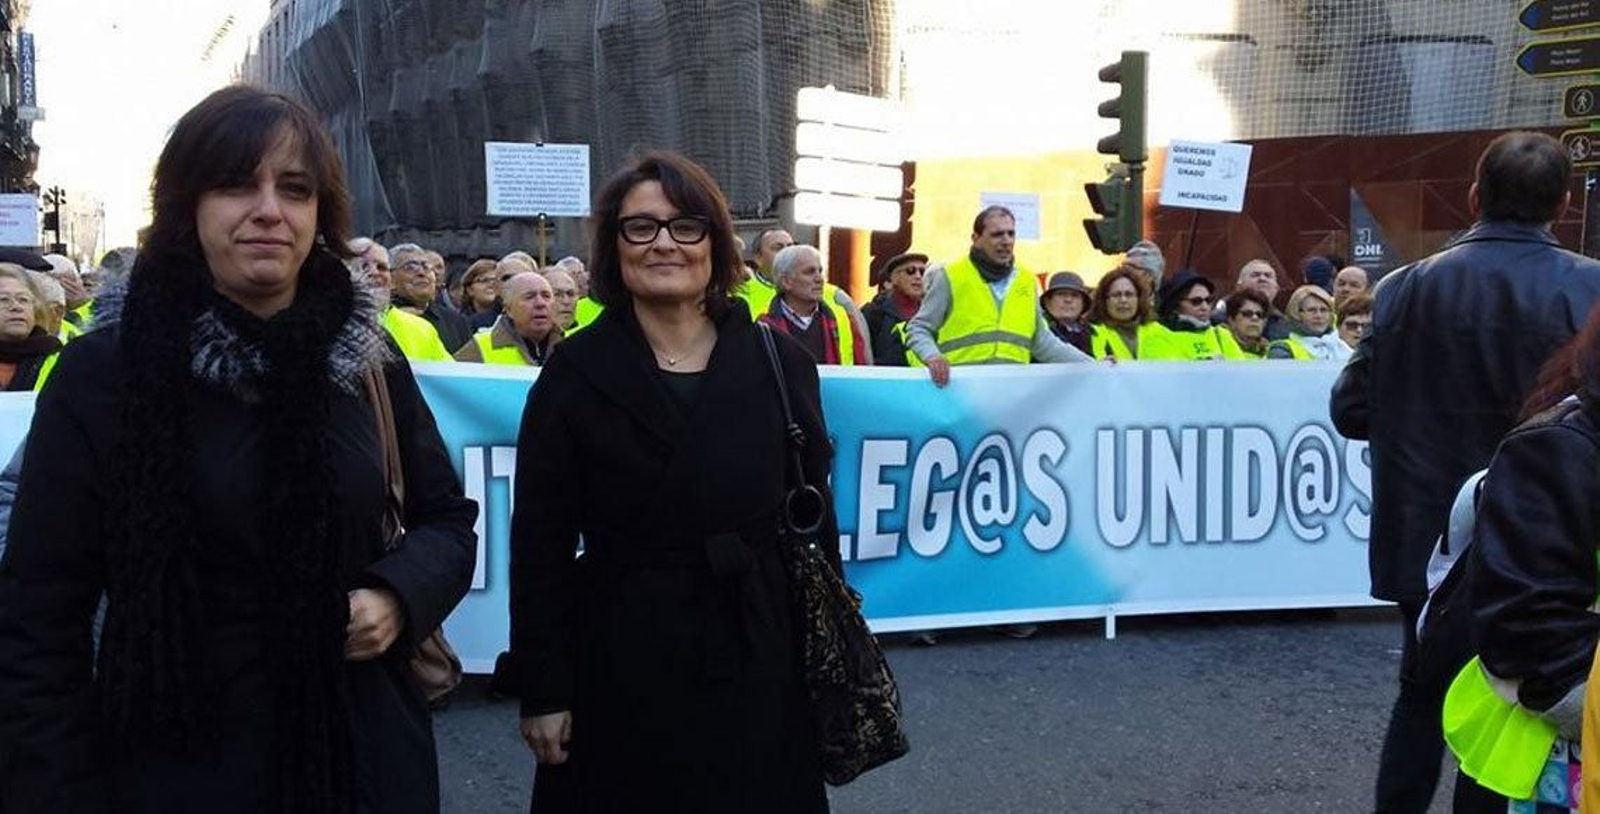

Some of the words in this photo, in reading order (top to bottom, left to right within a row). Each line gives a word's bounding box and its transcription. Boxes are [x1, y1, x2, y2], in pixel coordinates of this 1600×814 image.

[1173, 145, 1216, 157] QUEREMOS
[1173, 156, 1212, 167] IGUALDAD
[1178, 168, 1206, 178] GRADO
[1178, 190, 1228, 202] INCAPACIDAD
[1354, 244, 1383, 256] DHL
[838, 427, 1069, 561] EG@S
